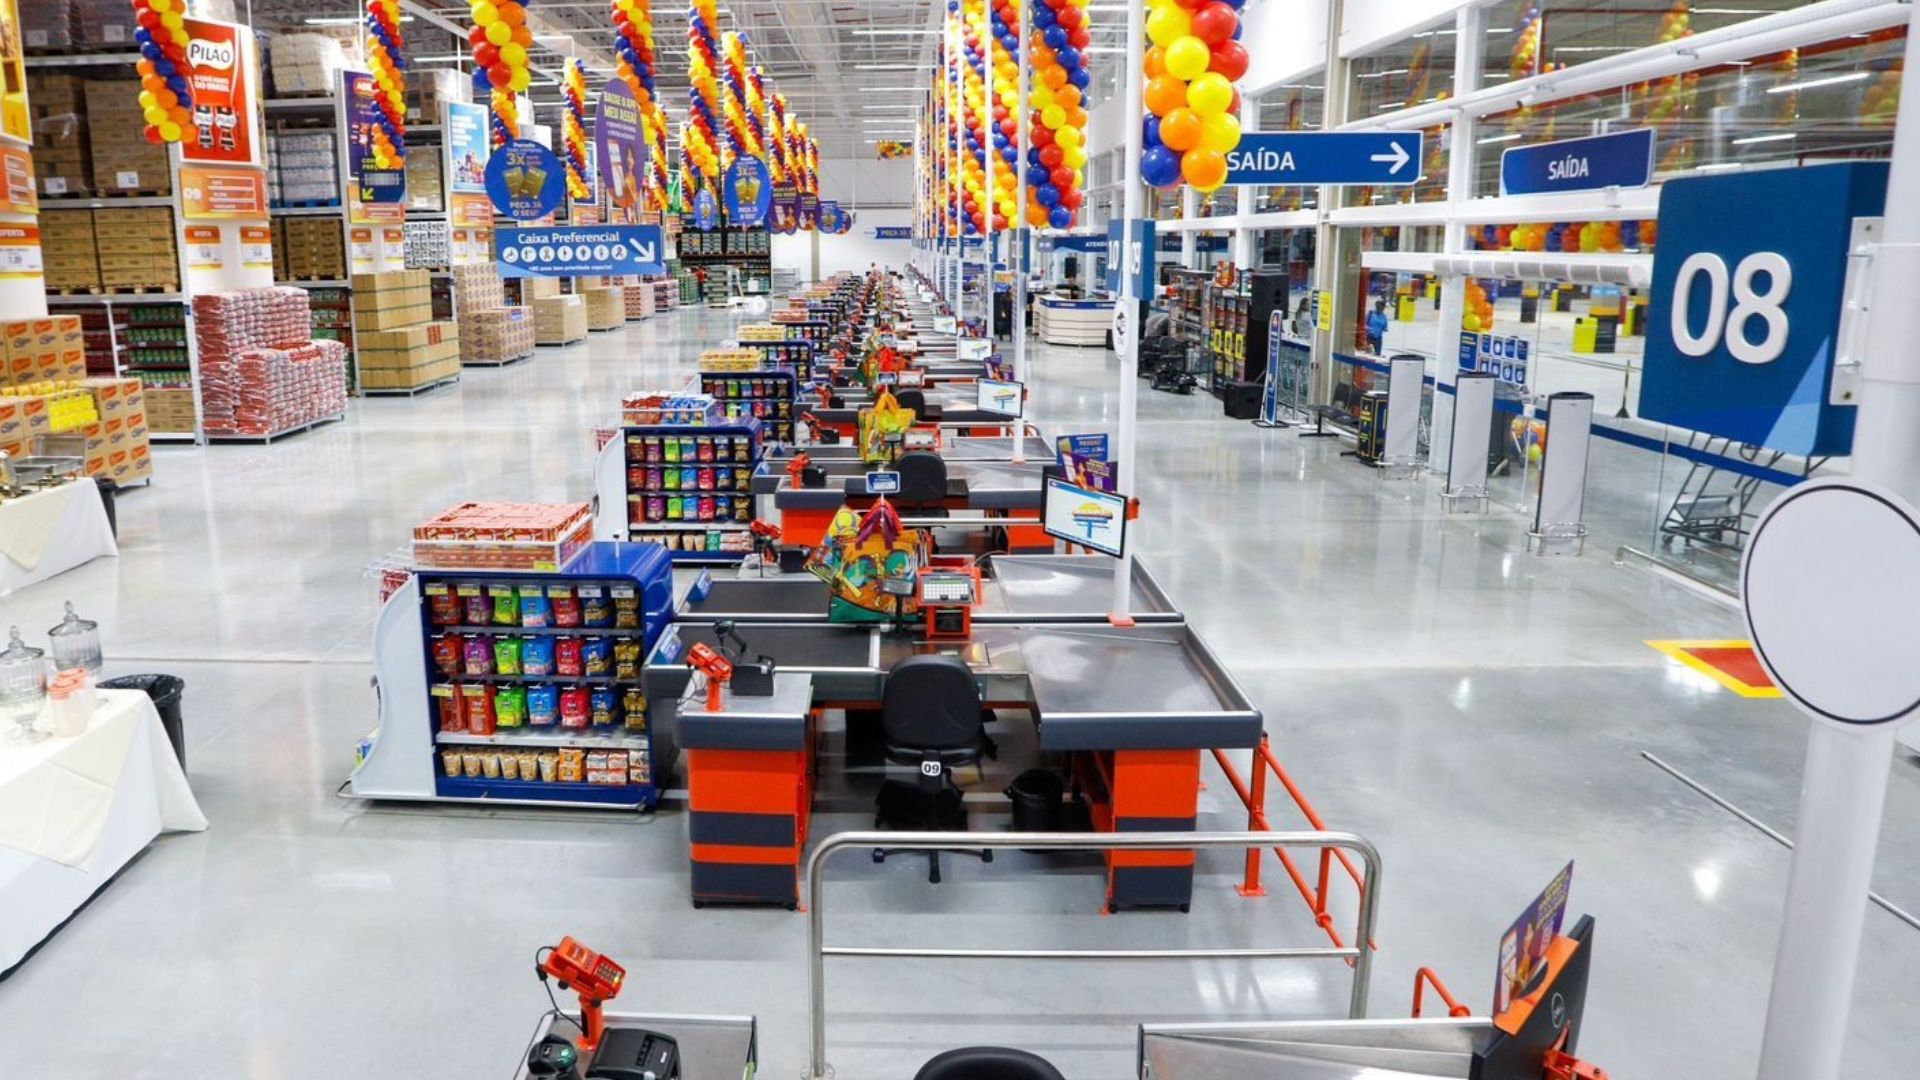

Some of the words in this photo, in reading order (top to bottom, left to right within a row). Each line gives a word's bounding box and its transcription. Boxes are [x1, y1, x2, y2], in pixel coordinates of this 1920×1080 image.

[1227, 147, 1296, 171] SAÍDA
[1548, 154, 1589, 180] SAÍDA
[518, 233, 549, 244] Caixa
[552, 231, 620, 243] Preferencial
[1671, 251, 1792, 364] 08
[924, 763, 939, 774] 09
